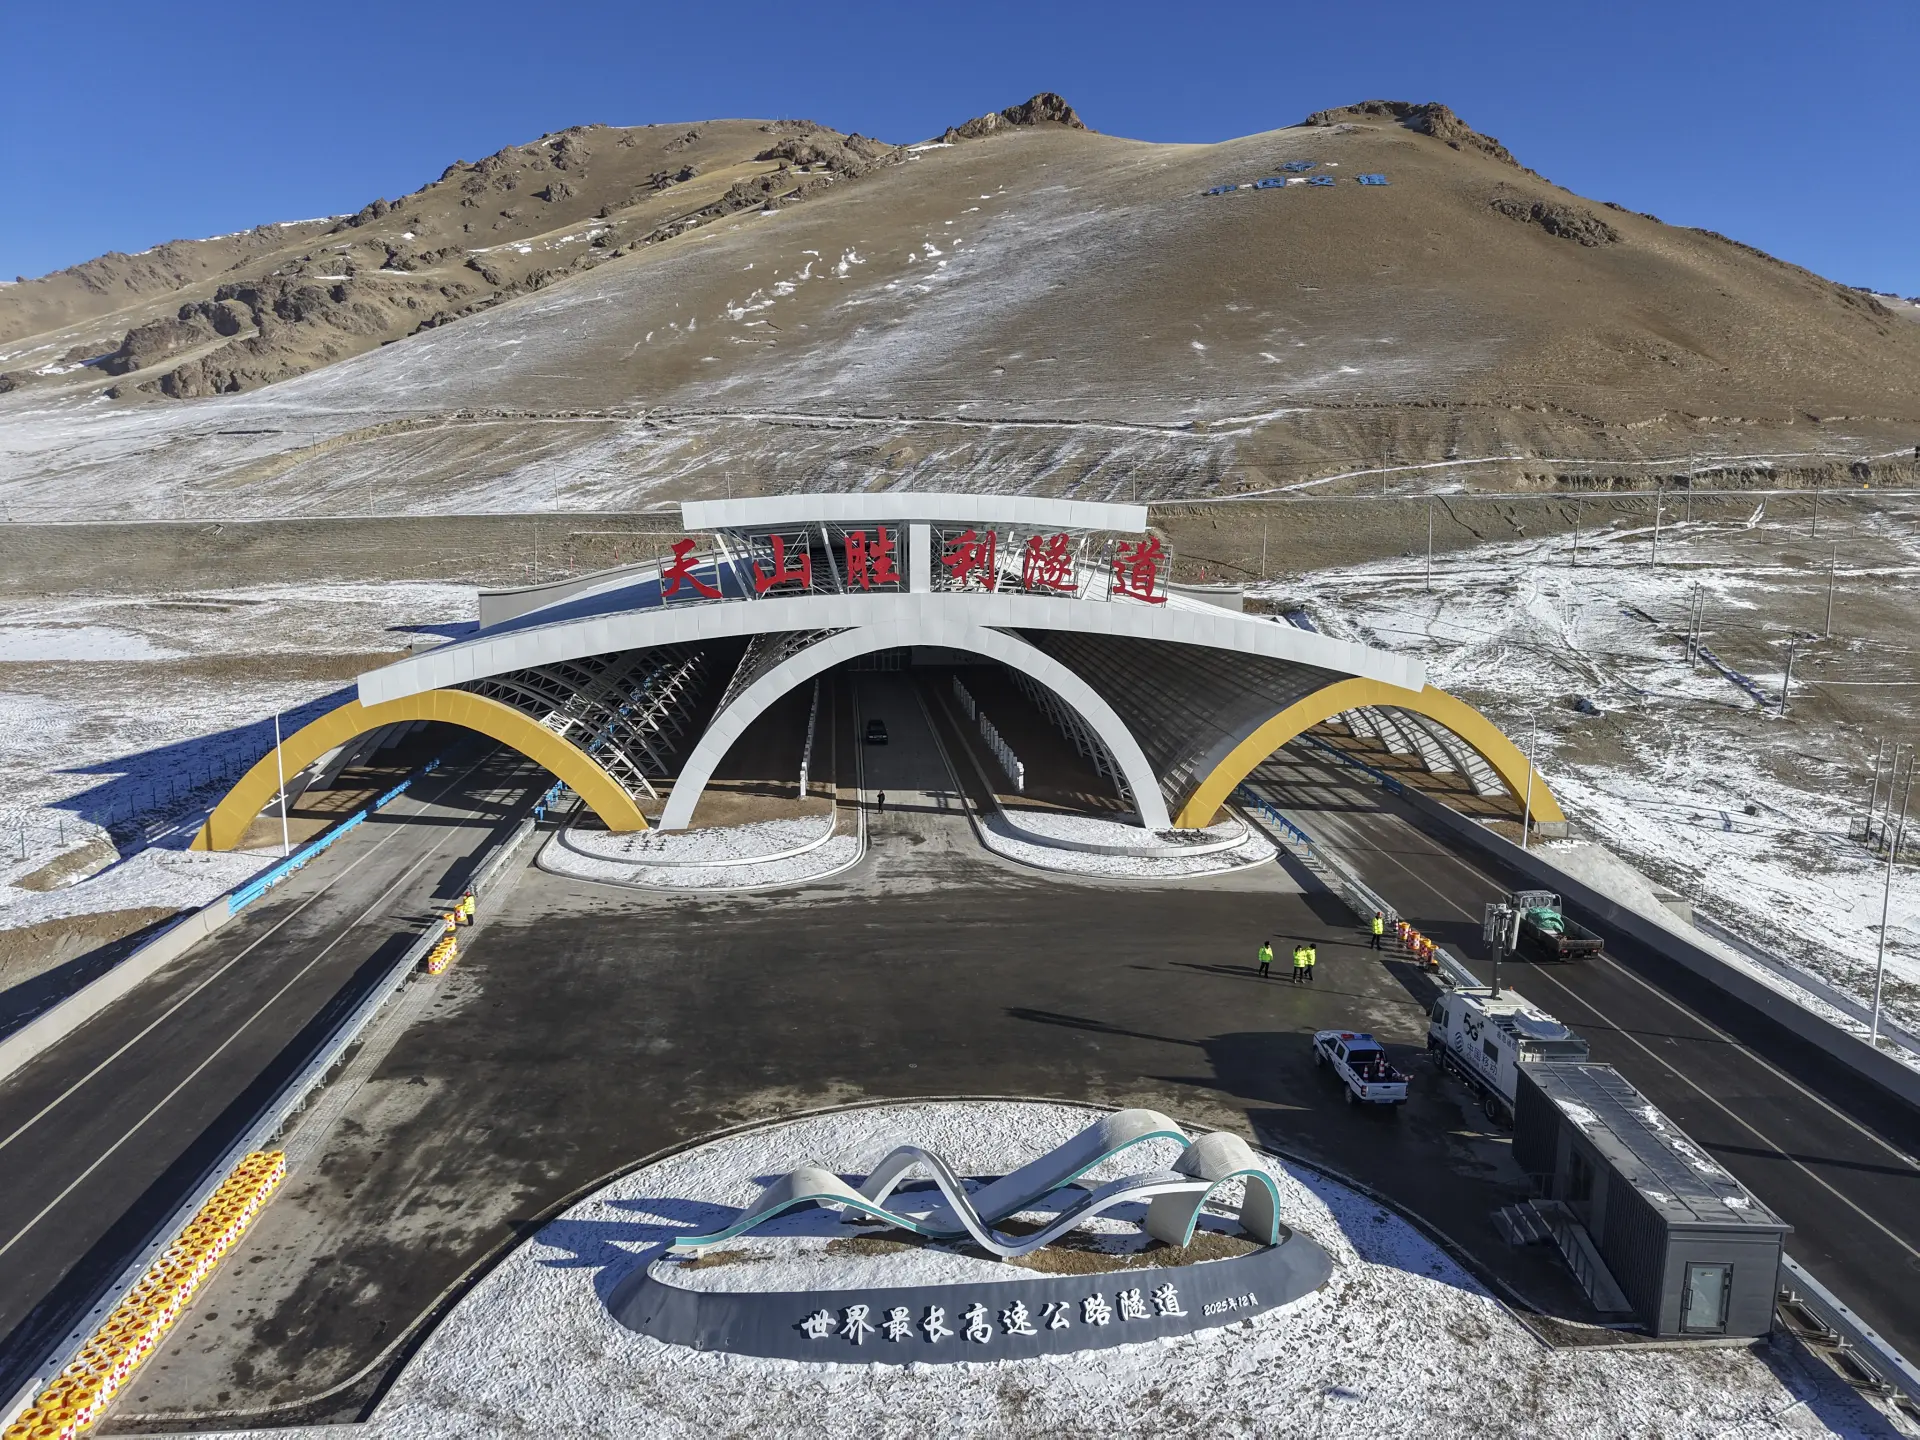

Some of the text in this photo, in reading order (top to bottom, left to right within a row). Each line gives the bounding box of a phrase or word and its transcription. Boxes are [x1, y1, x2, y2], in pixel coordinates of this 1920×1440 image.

[663, 527, 1168, 604] 天山胜利隧道
[801, 1283, 1188, 1345] 世界最长高速公路隧道
[1203, 1292, 1259, 1316] 2025年12月
